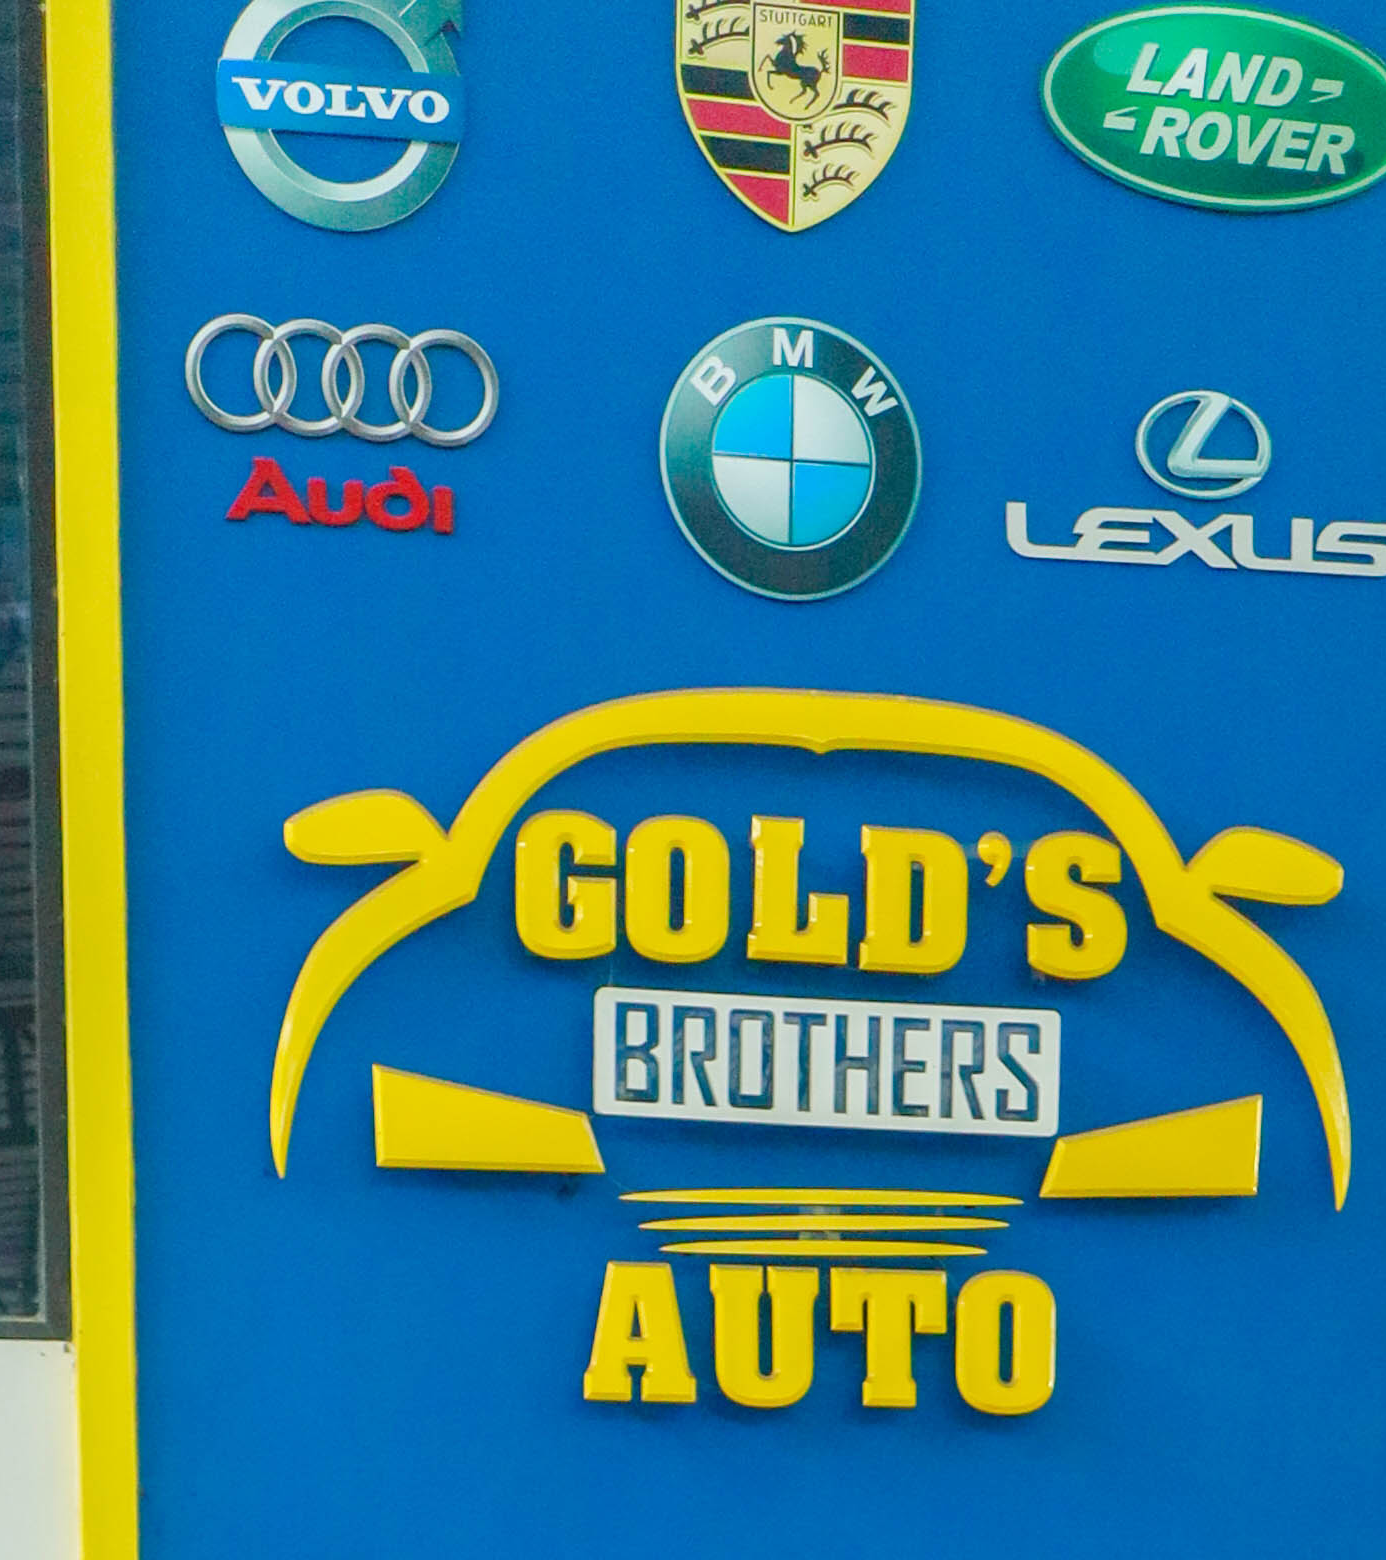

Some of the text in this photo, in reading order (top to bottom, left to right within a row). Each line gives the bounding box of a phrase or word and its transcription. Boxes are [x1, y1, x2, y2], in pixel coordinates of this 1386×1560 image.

[759, 8, 833, 27] STUTTGART
[232, 76, 450, 124] VOLVO
[1126, 42, 1304, 108] LAND
[1139, 106, 1356, 175] ROVER
[690, 327, 899, 419] BMW
[226, 456, 454, 535] Audi
[514, 808, 1129, 981] GOLD'S
[613, 1001, 1042, 1123] BROTHERS
[583, 1260, 1058, 1416] AUTO
